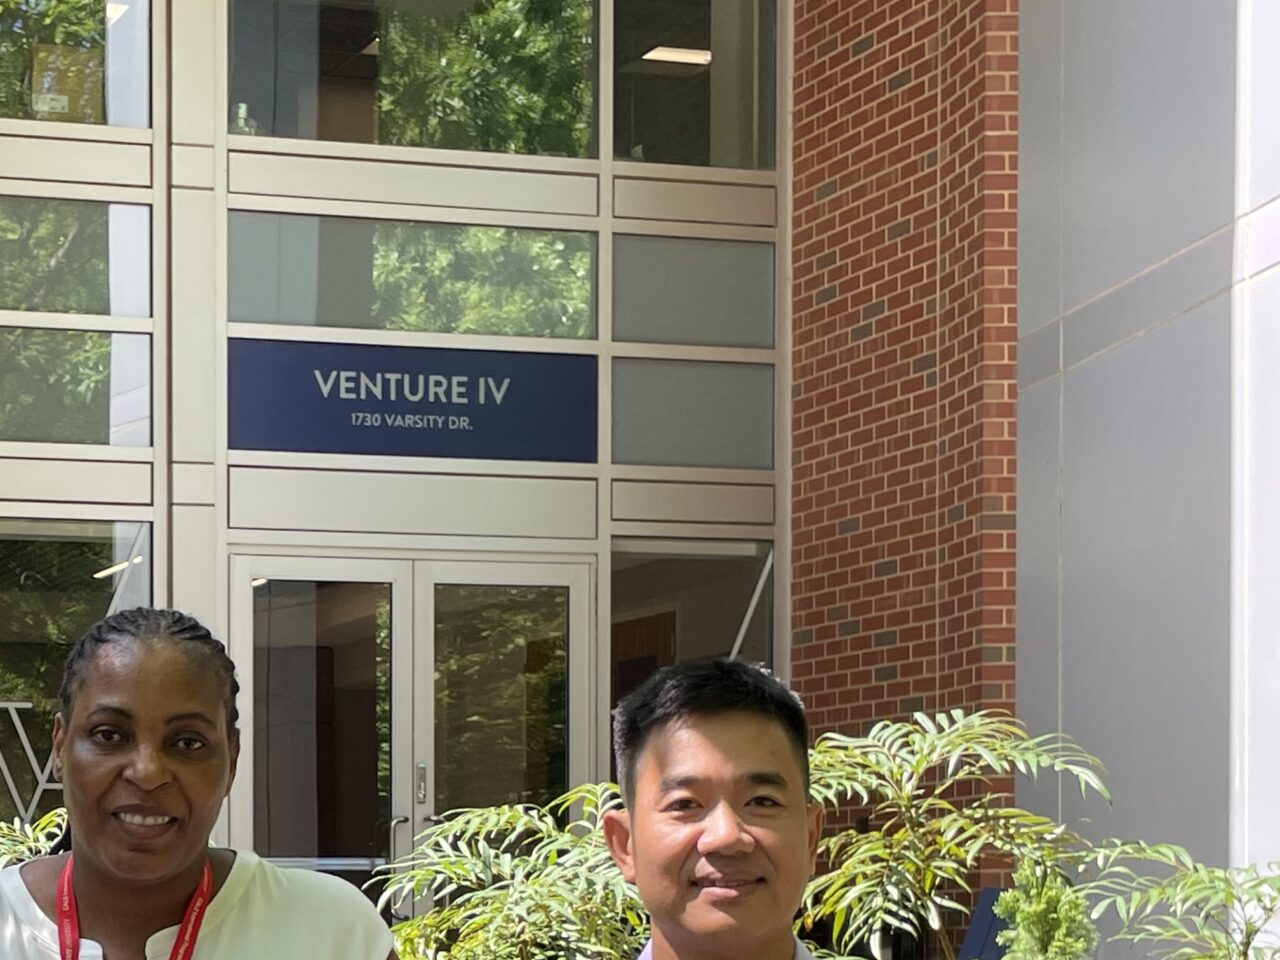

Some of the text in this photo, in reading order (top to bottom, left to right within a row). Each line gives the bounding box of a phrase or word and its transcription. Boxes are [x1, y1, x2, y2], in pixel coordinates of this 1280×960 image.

[314, 370, 510, 405] VENTURE IV
[351, 412, 473, 430] 1730 VARSITY DR.
